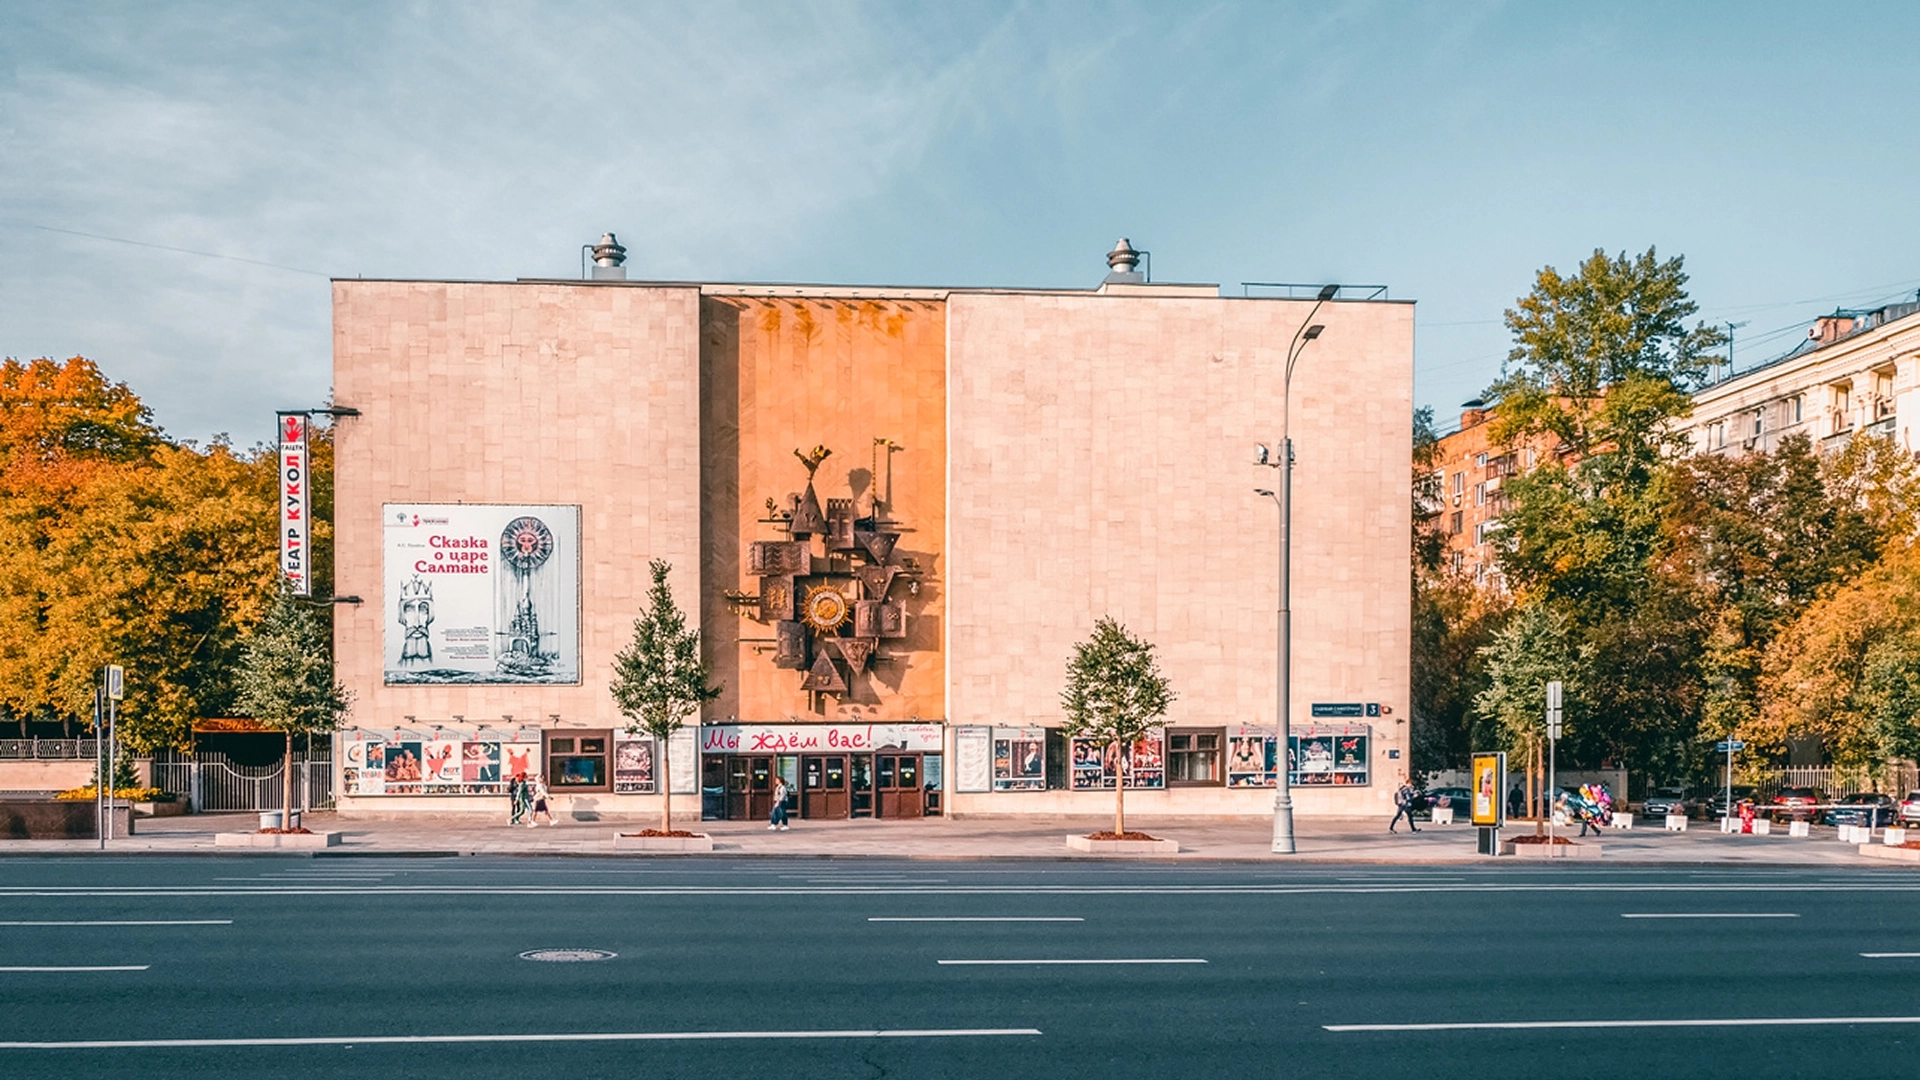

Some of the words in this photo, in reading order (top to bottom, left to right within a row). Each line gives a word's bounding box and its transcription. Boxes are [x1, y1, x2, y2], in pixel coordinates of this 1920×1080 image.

[286, 455, 300, 520] КУКОЛ
[429, 535, 488, 548] Сказка
[287, 528, 301, 580] ТЕАТР
[434, 552, 444, 560] о
[450, 552, 488, 563] царе
[414, 560, 489, 574] Салтане
[703, 728, 740, 750] Мы
[750, 731, 818, 752] ждём
